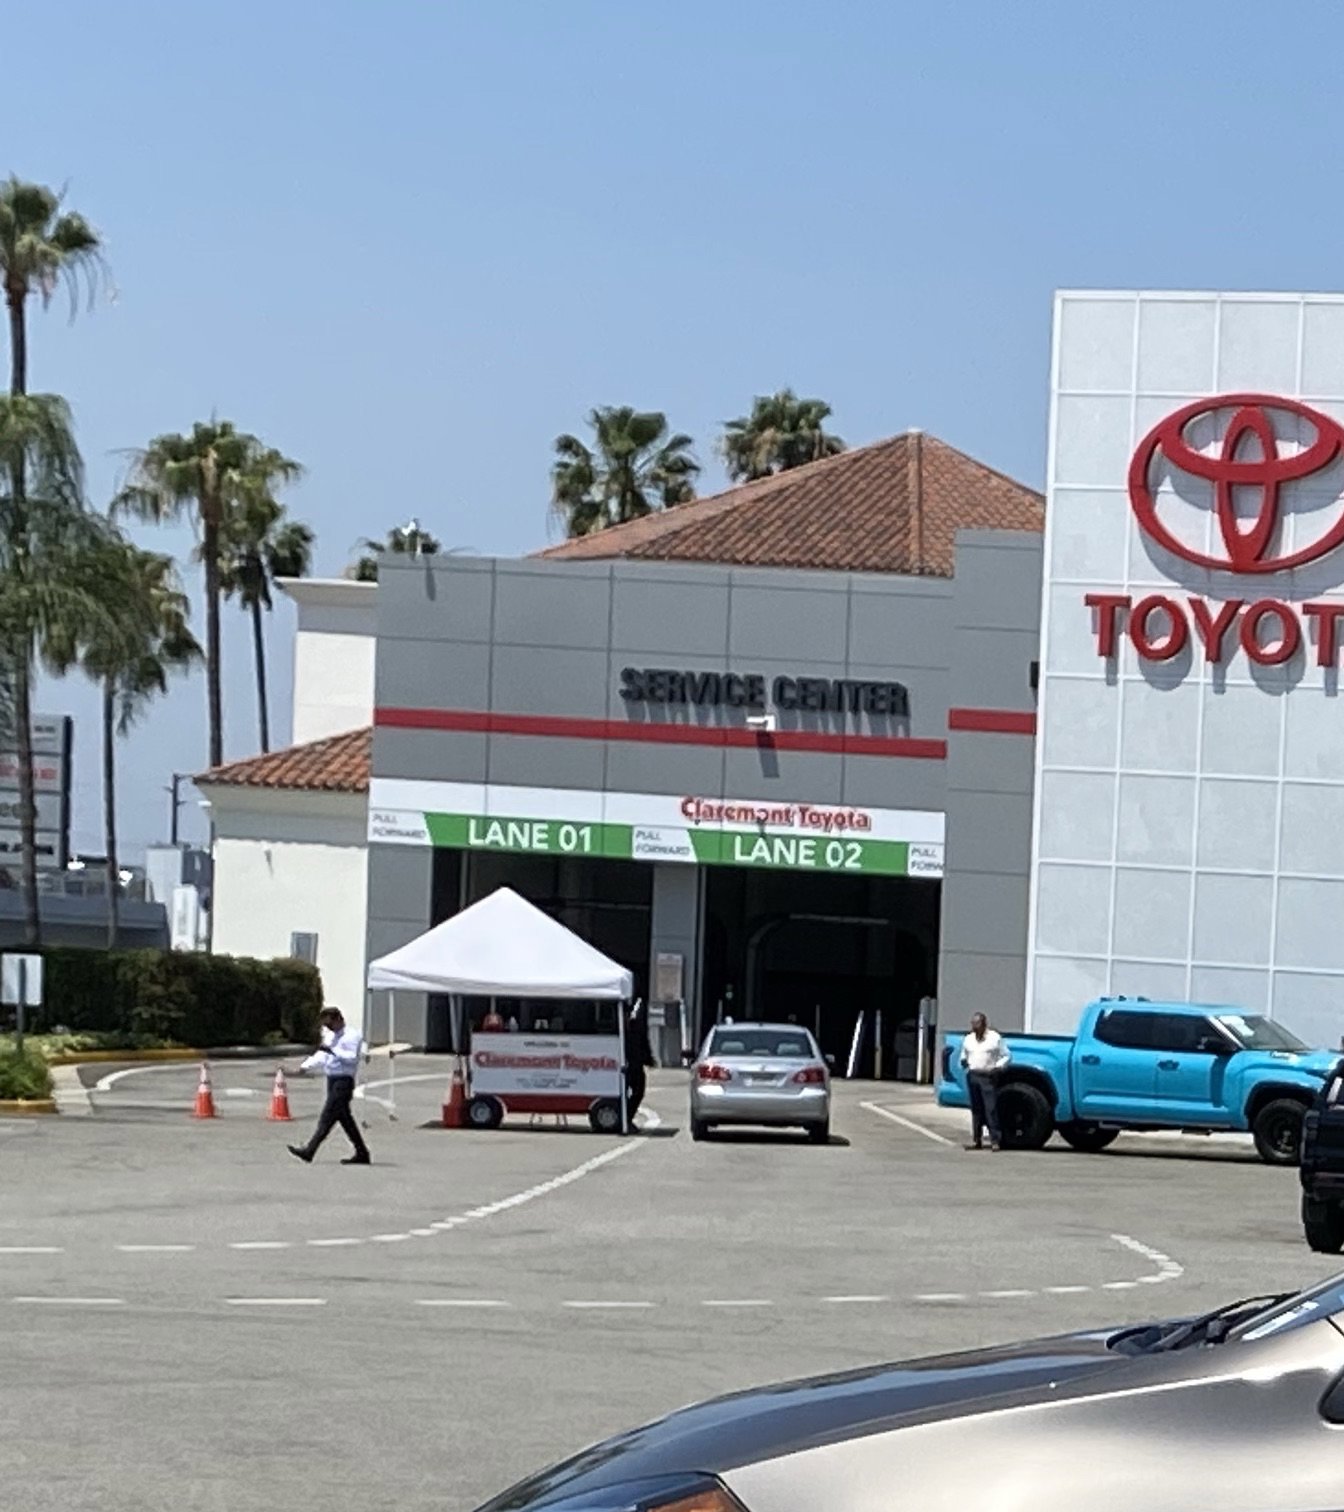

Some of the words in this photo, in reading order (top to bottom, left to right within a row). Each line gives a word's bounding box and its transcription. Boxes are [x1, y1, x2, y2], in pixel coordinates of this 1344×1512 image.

[619, 667, 765, 708] SERVICE
[771, 674, 908, 717] CENTER
[680, 796, 793, 824] Claremont
[799, 806, 873, 833] Toyota
[467, 818, 549, 849] LANE
[558, 824, 593, 853] 01
[734, 835, 818, 865] LANE
[825, 839, 863, 869] 02
